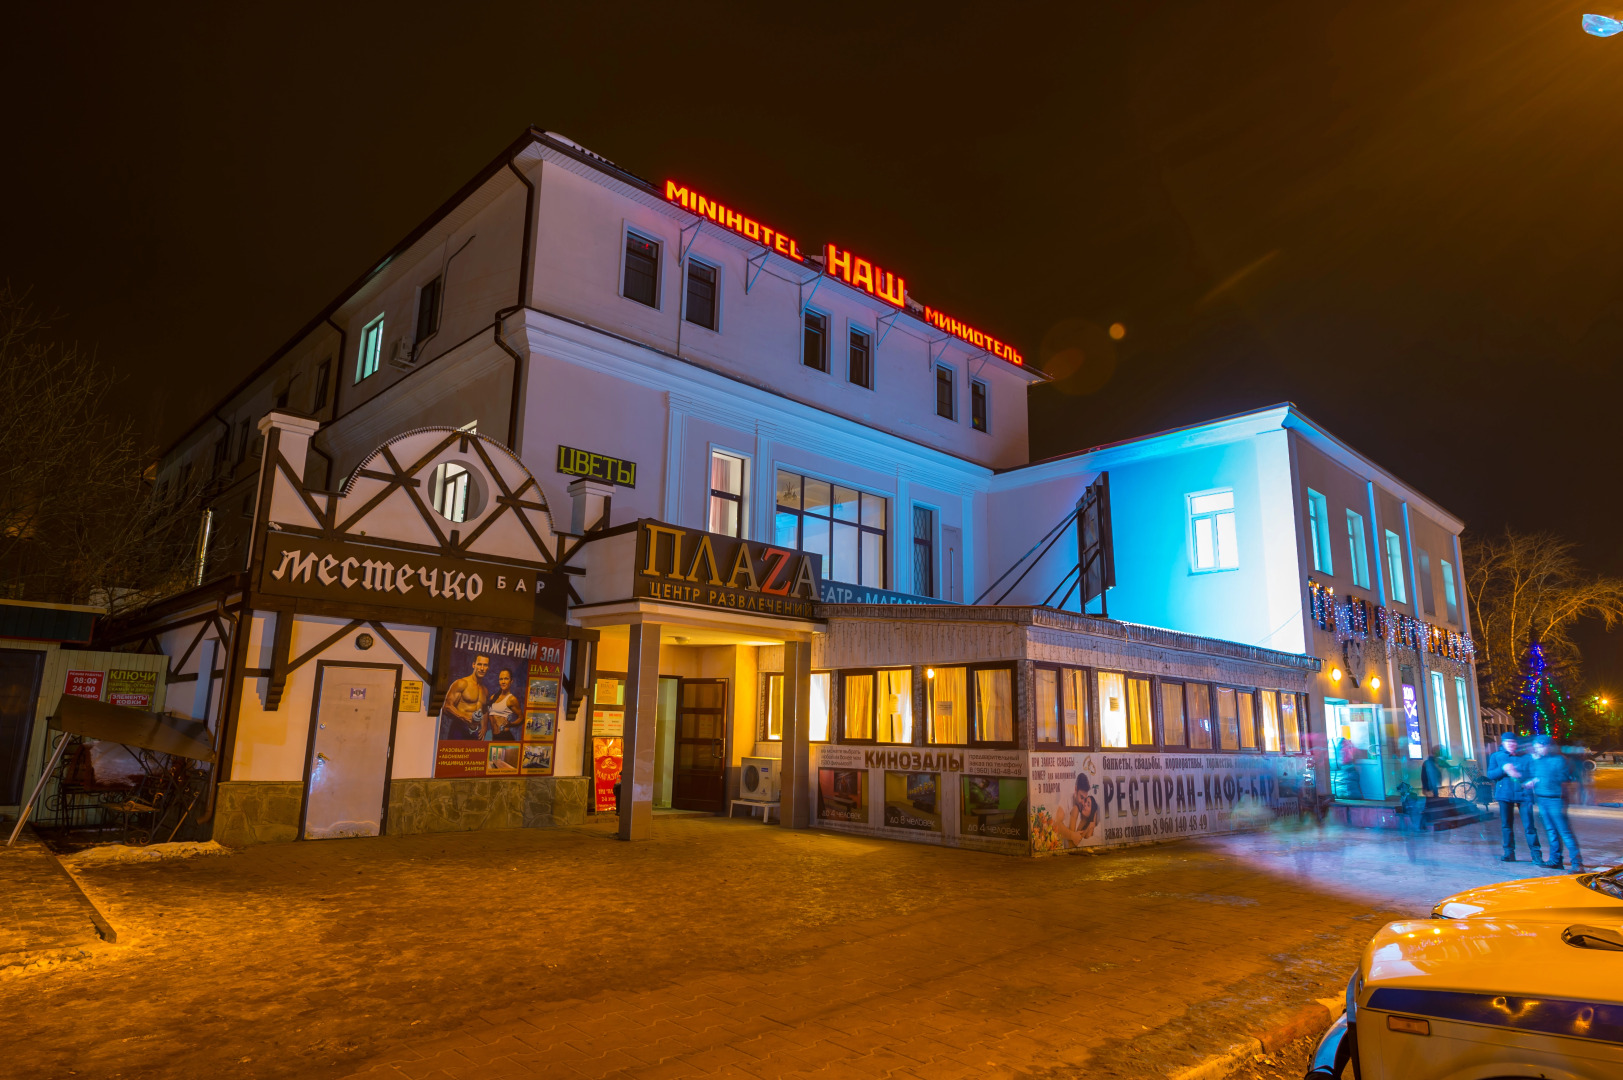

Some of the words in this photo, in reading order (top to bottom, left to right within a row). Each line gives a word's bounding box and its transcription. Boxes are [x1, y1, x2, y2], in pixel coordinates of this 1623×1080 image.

[666, 180, 803, 261] MINIHOTEL
[826, 243, 906, 308] НАШ
[925, 305, 1023, 366] МИНИОТЕЛЬ
[559, 446, 636, 486] ЦВЕТЫ
[496, 575, 546, 594] БАР
[650, 582, 701, 601] ЦЕНТР
[709, 590, 813, 618] РАЗВЛЕЧЕНИЙ
[454, 631, 539, 661] ТРЕНАЖЁРНЫЙ
[540, 646, 560, 664] ЗАЛ
[73, 677, 97, 685] 08:00
[110, 670, 156, 681] КЛЮЧИ
[71, 685, 95, 693] 24:00
[865, 750, 965, 773] КИНОЗАЛЫ
[1102, 756, 1133, 771] банкеты,
[1134, 756, 1163, 771] свадьбы,
[1043, 782, 1061, 794] ПОДАРОК
[979, 823, 985, 833] 4
[1104, 828, 1123, 840] заказ
[1124, 825, 1152, 838] столиков
[1160, 817, 1174, 834] 960
[1175, 816, 1187, 833] 140
[1188, 815, 1198, 832] 48
[1199, 814, 1208, 831] 49
